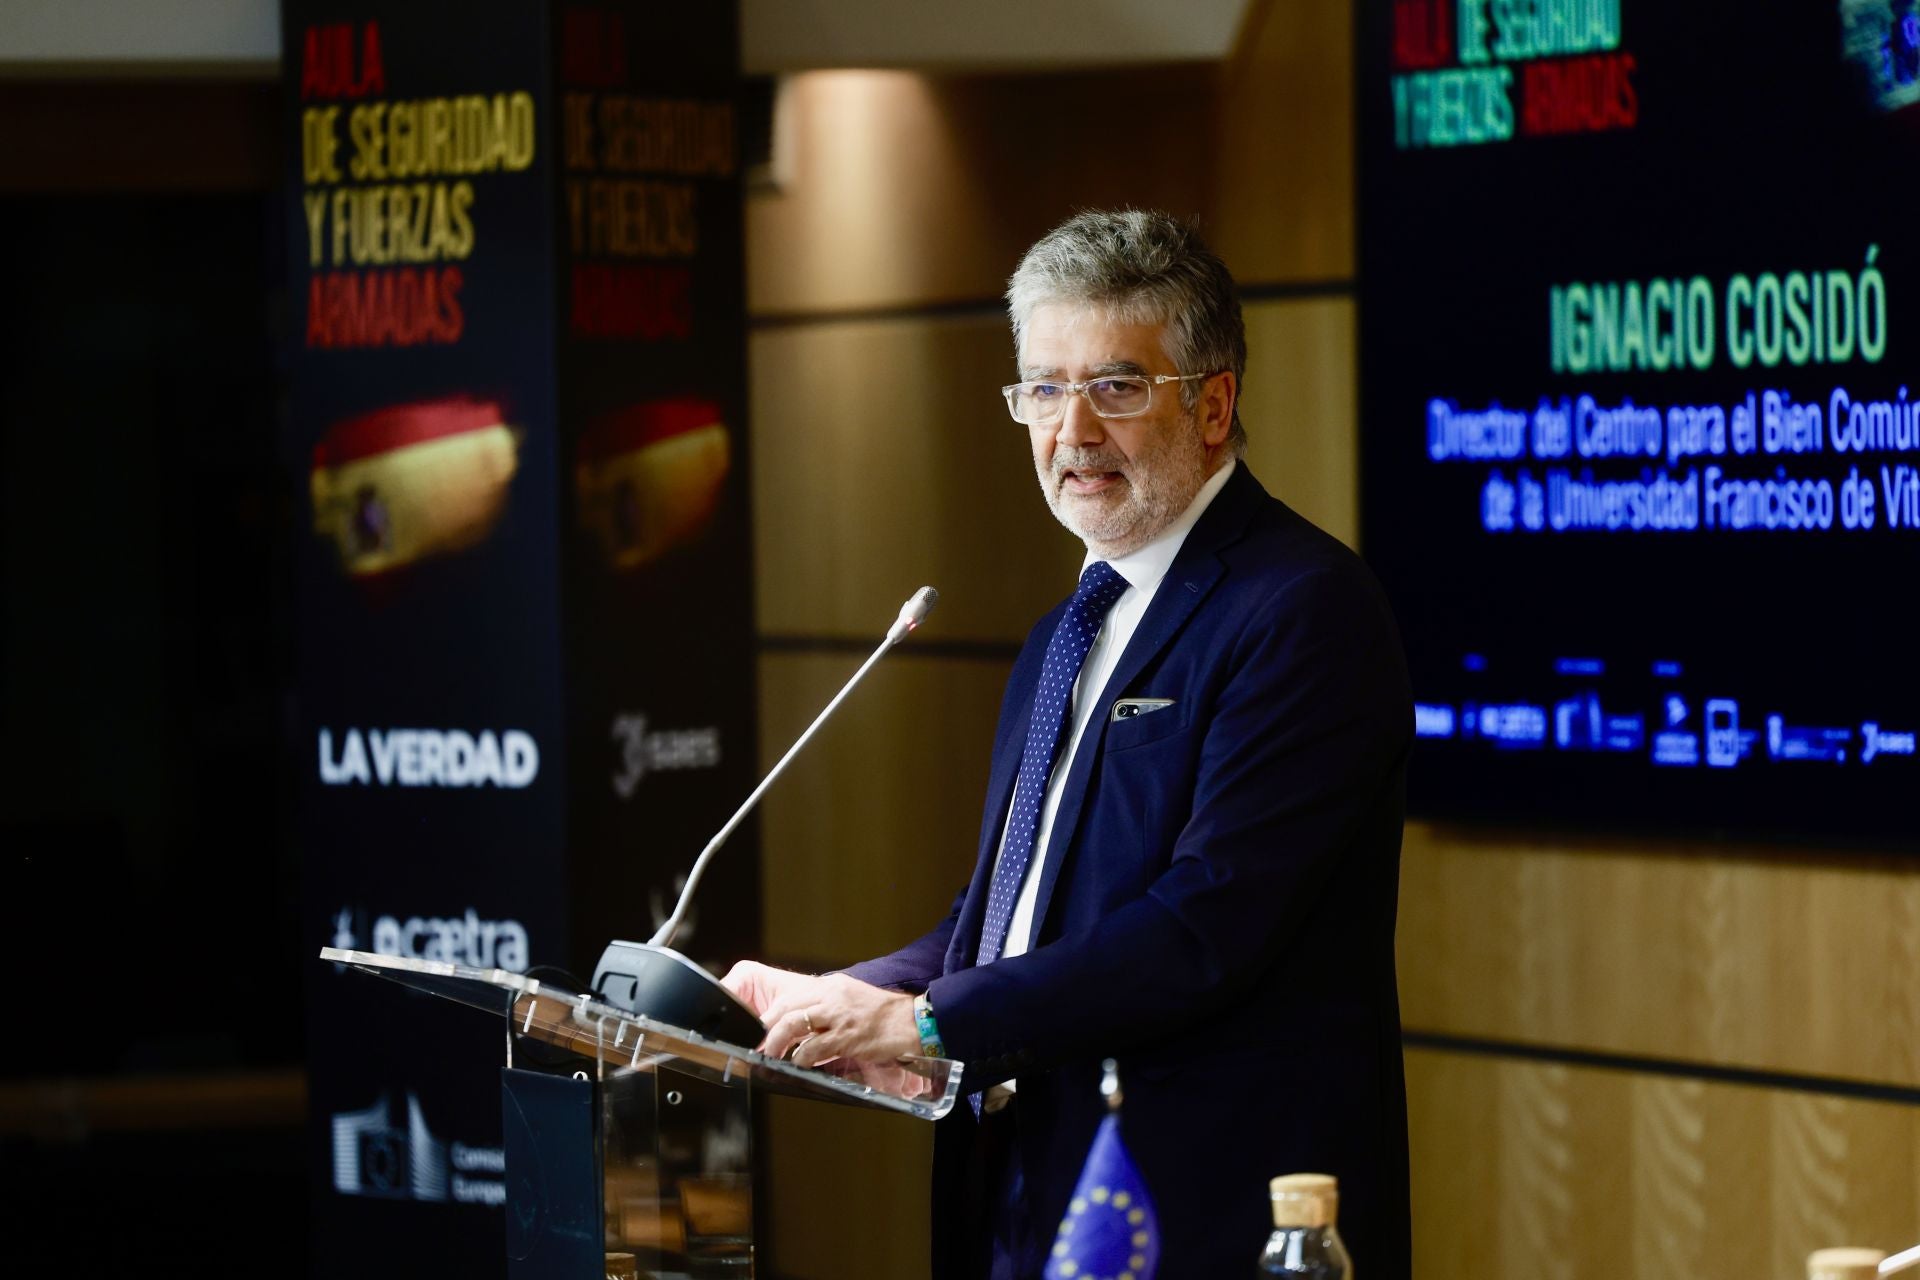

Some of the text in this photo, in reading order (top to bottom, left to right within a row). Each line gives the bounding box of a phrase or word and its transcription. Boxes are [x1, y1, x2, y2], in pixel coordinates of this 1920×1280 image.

[303, 19, 384, 97] AULA
[303, 90, 536, 185] DE SEGURIDAD
[303, 180, 475, 267] Y FUERZAS
[306, 265, 464, 348] ARMADAS
[1549, 241, 1887, 374] IGNACIO COSIDÓ
[1576, 392, 1662, 458] Centro
[1667, 404, 1727, 467] para
[1731, 390, 1757, 455] el
[1762, 388, 1823, 454] Bien
[1548, 467, 1699, 531] Universidad
[1704, 465, 1833, 530] Francisco
[1840, 465, 1876, 530] de
[1881, 464, 1920, 528] Vit
[317, 725, 541, 789] LA VERDAD
